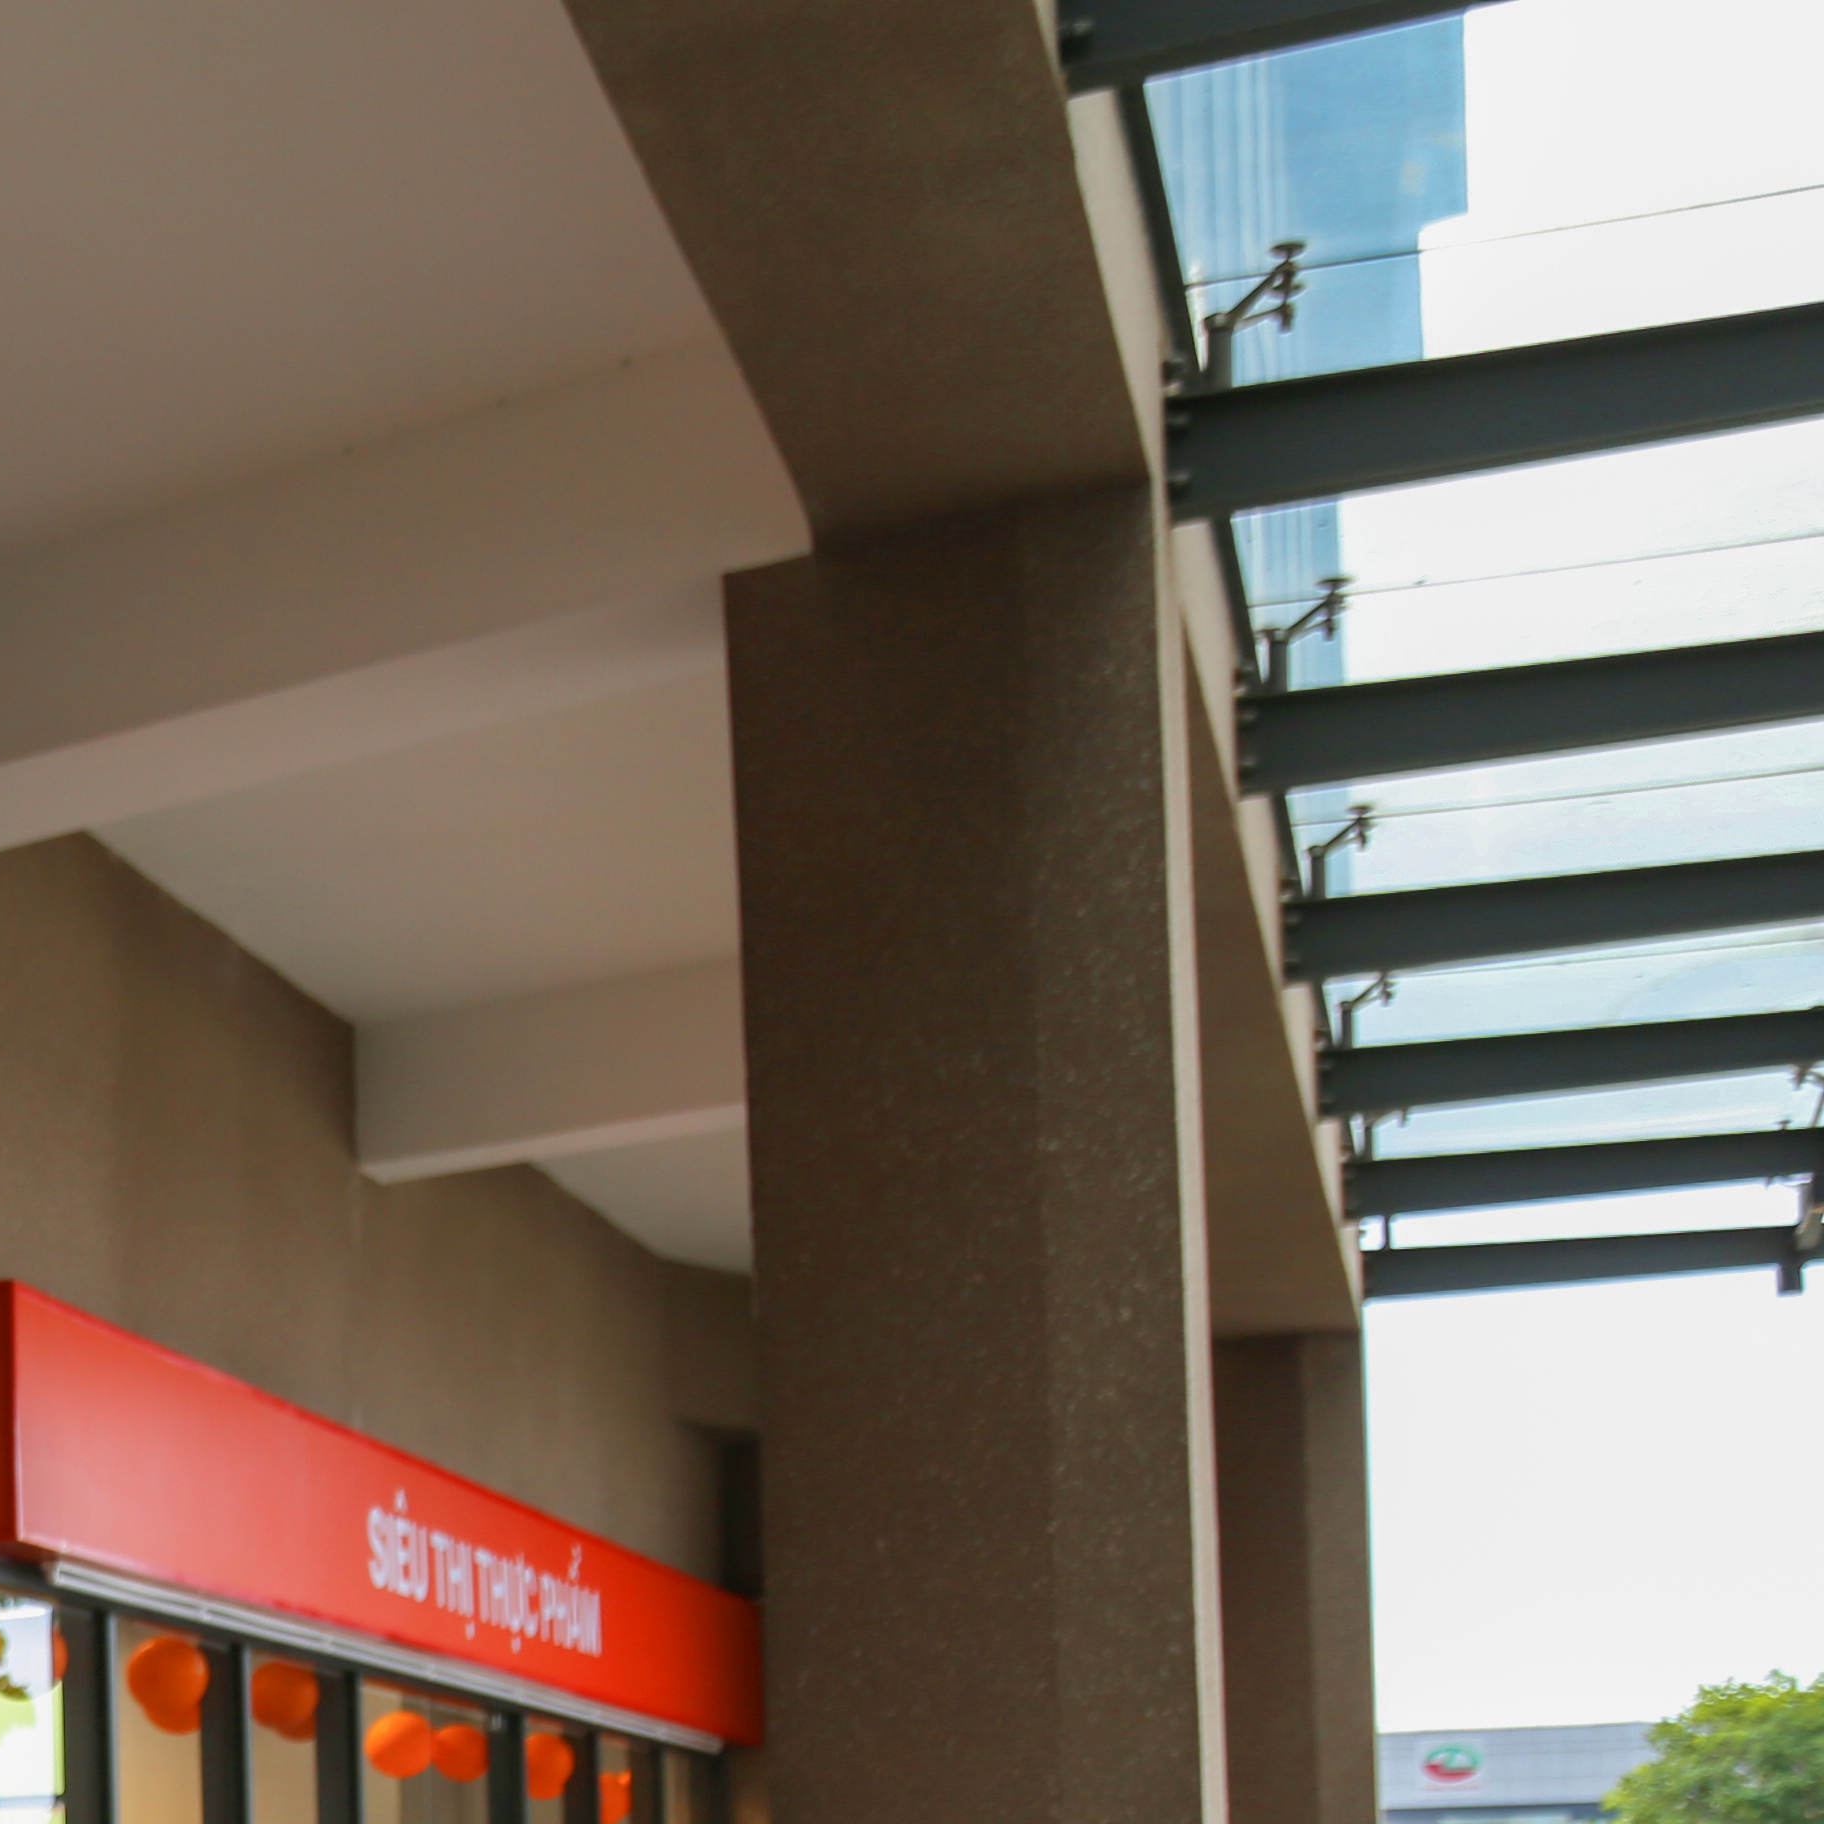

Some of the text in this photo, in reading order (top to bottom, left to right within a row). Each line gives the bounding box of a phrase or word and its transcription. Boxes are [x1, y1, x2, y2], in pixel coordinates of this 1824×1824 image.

[367, 1488, 602, 1658] SIÊU THỊ THỰC PHẨM
